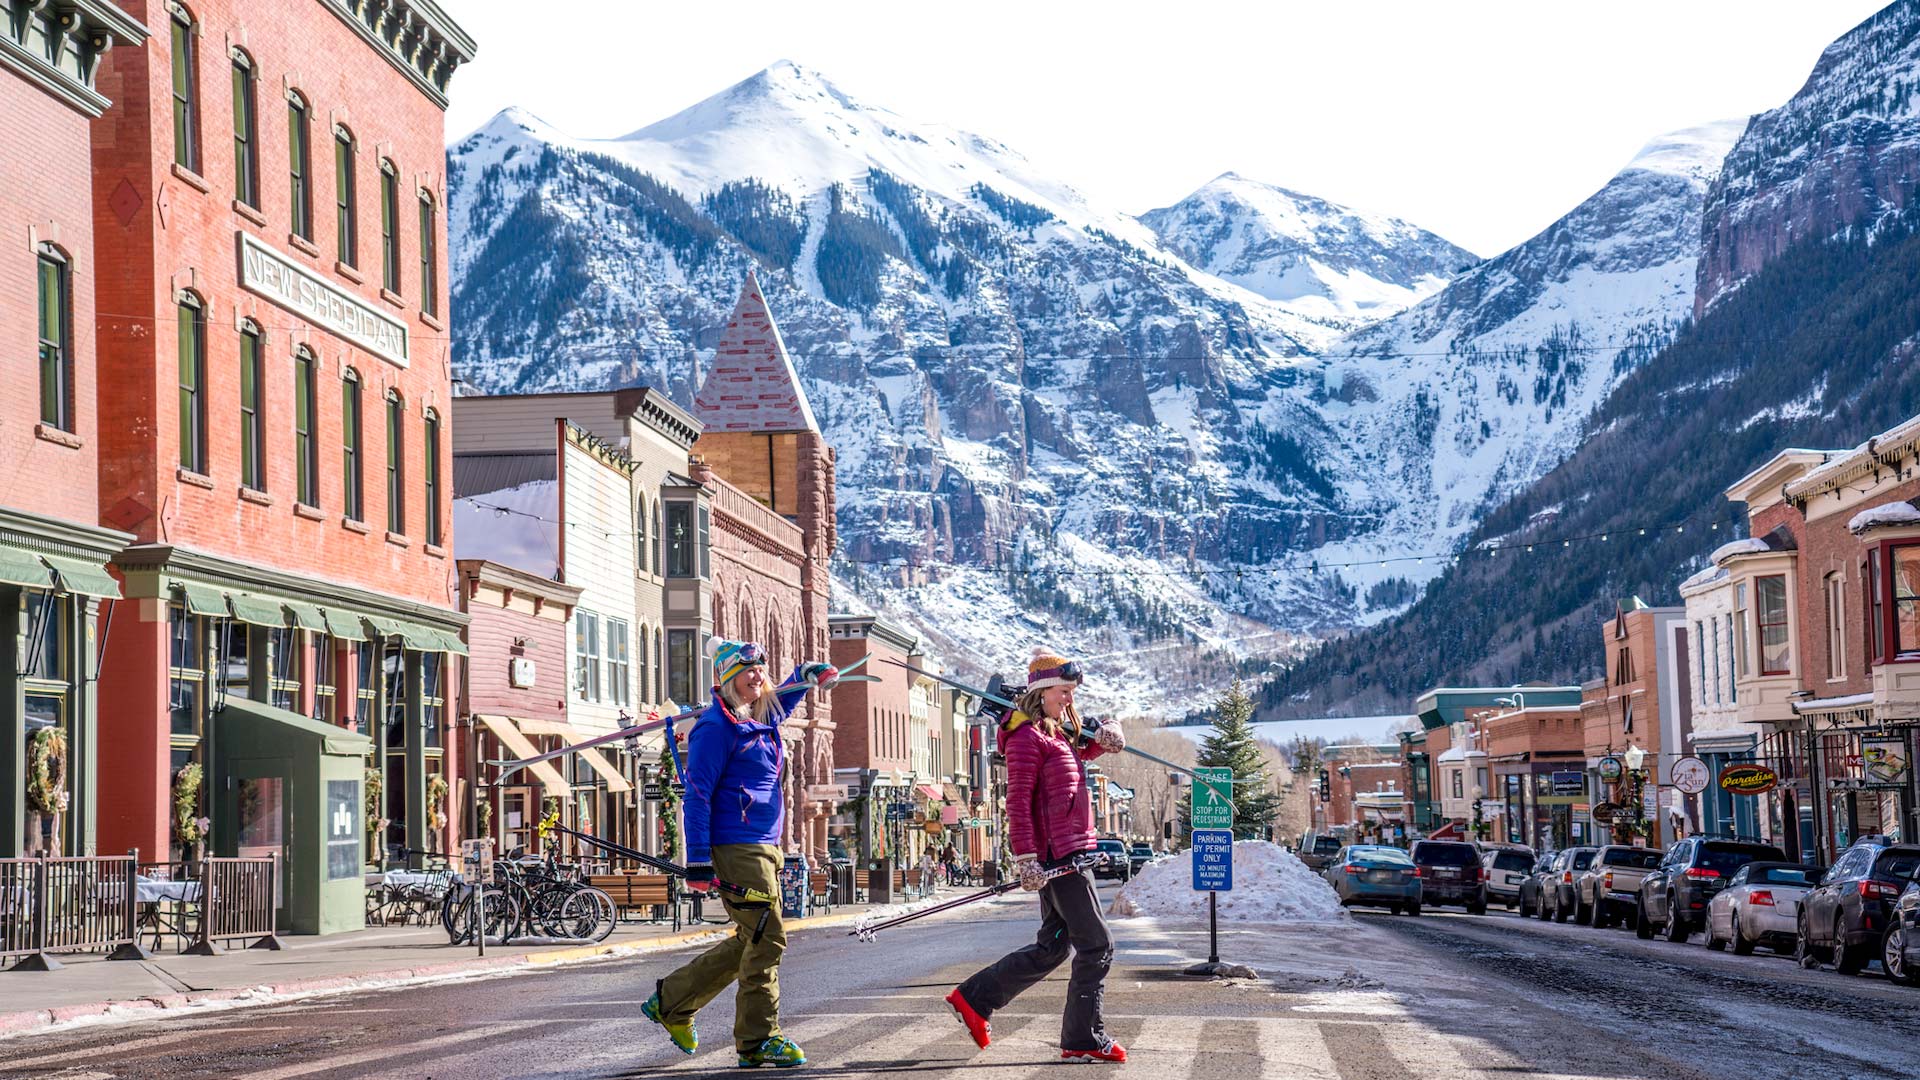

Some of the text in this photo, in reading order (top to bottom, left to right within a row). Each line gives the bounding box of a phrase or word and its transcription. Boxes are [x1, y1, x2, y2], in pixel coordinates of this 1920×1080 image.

[245, 250, 401, 355] NEW SHERIDAN
[1673, 770, 1693, 785] Zia
[1722, 771, 1774, 788] Paradise
[1684, 778, 1704, 791] Sun
[1196, 806, 1228, 815] STOP FOR
[1193, 815, 1231, 824] PEDESTRIANS
[1197, 835, 1227, 844] PARKING
[1193, 844, 1231, 853] BY PERMIT
[1203, 854, 1221, 863] ONLY
